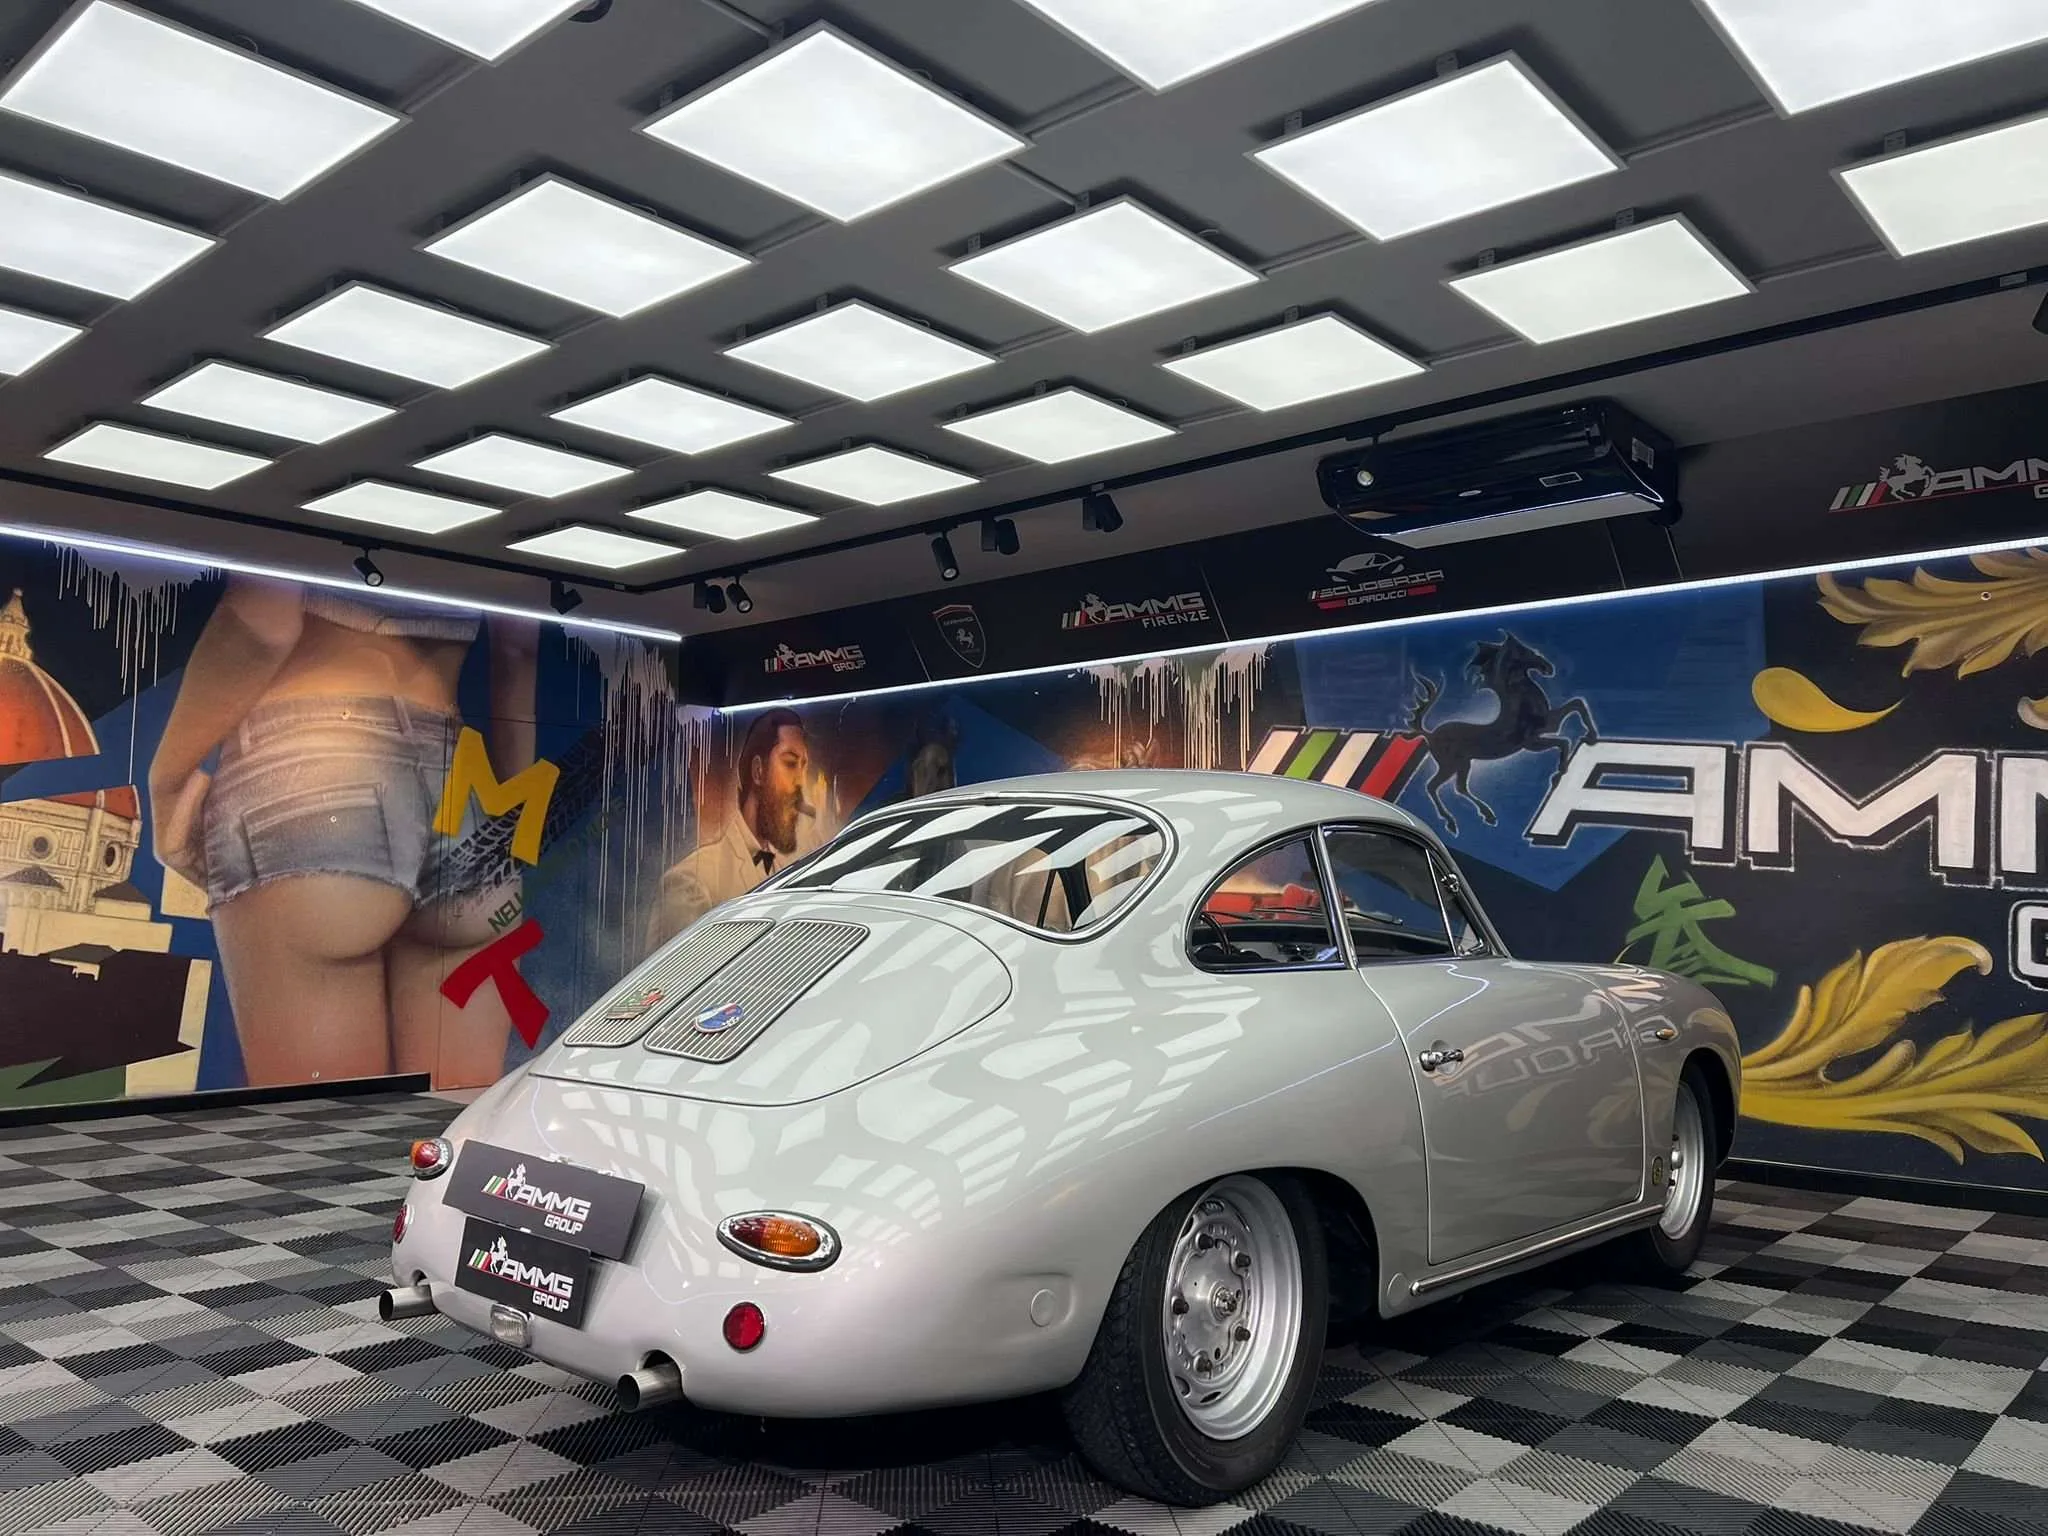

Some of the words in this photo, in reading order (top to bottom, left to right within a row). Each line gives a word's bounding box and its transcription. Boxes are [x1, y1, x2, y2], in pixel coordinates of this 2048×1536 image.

[1106, 592, 1204, 621] AMMG
[1142, 609, 1210, 629] FIRENZE
[794, 644, 864, 668] AMMG
[832, 659, 867, 673] GROUP
[1523, 737, 2048, 888] AM
[513, 1184, 591, 1220] AMMG
[544, 1214, 583, 1234] GROUP
[501, 1260, 573, 1297] AMMG
[532, 1291, 569, 1312] GROUP
